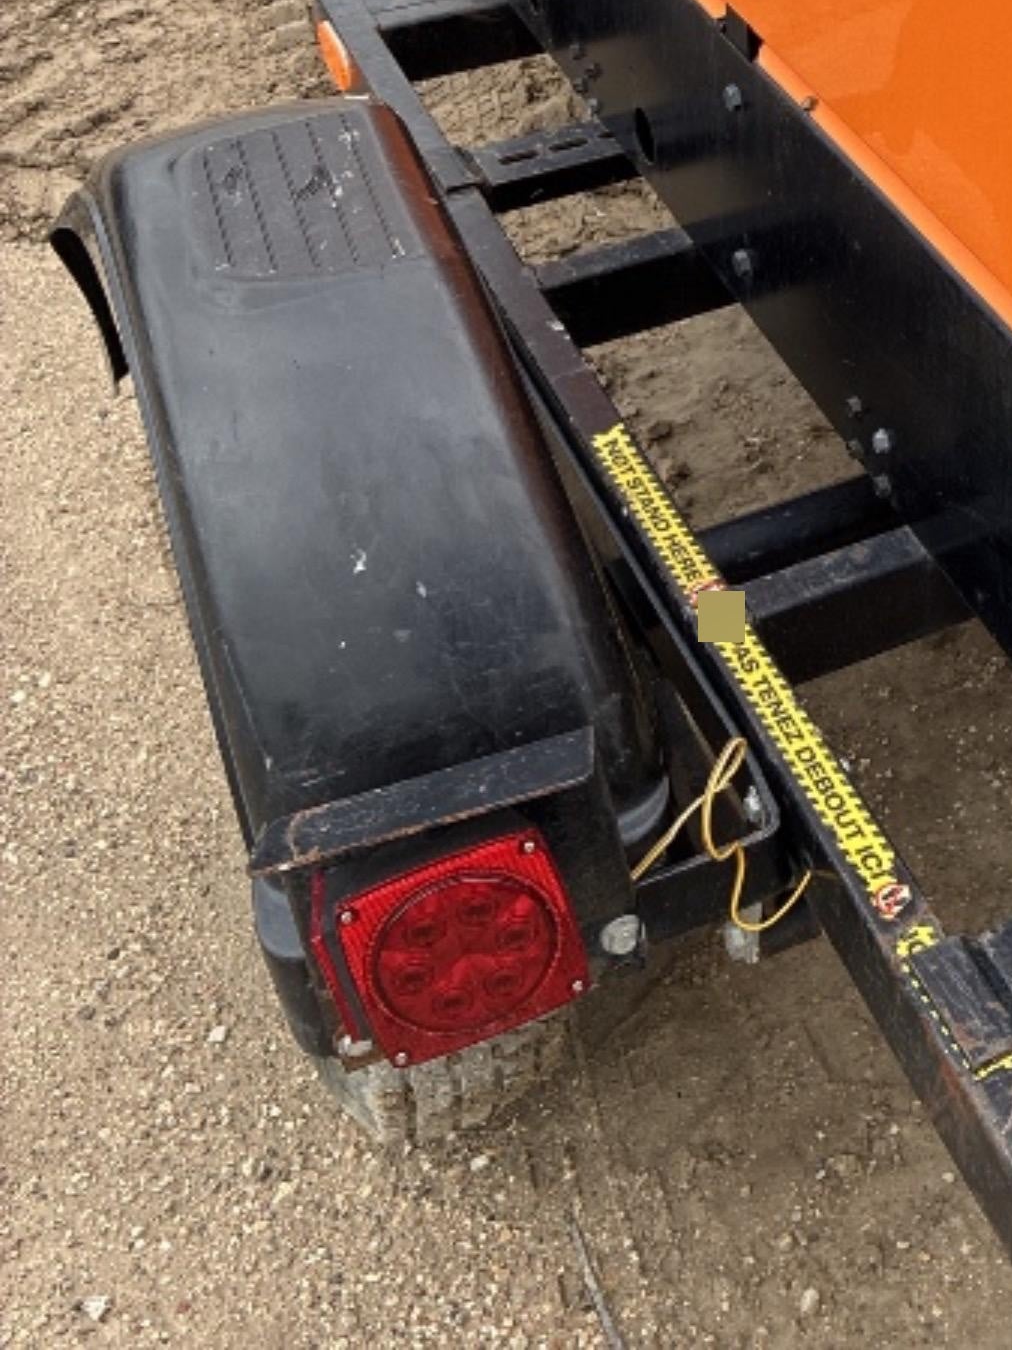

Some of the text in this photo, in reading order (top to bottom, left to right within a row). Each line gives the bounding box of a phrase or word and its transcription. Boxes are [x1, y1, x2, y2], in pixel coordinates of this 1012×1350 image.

[626, 475, 672, 533] STAND
[664, 533, 707, 584] HERE
[735, 641, 760, 674] AS
[752, 673, 804, 744] TENEZ
[795, 746, 866, 841] DEBOUT
